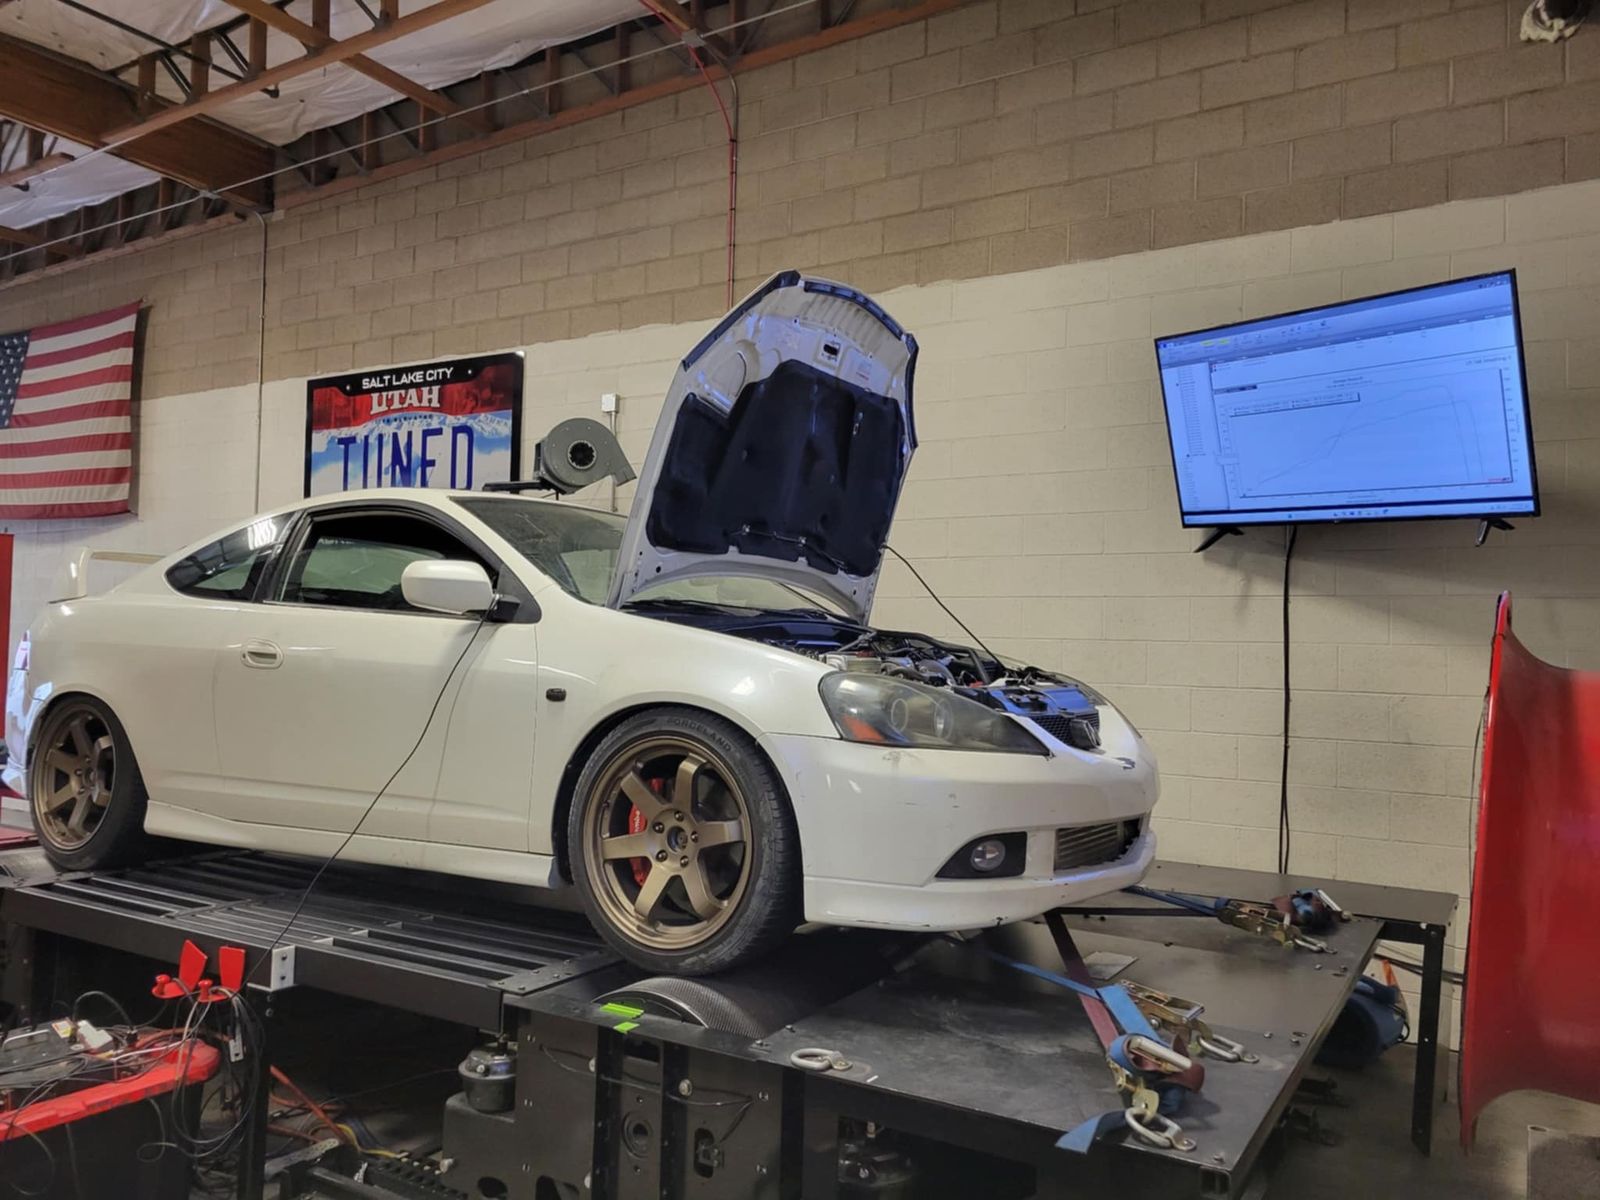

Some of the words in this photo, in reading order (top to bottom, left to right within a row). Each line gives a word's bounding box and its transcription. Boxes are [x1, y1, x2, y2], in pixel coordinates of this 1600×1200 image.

[362, 375, 391, 389] SALT
[393, 371, 424, 386] LAKE
[426, 367, 454, 381] CITY
[370, 385, 441, 415] UTAH
